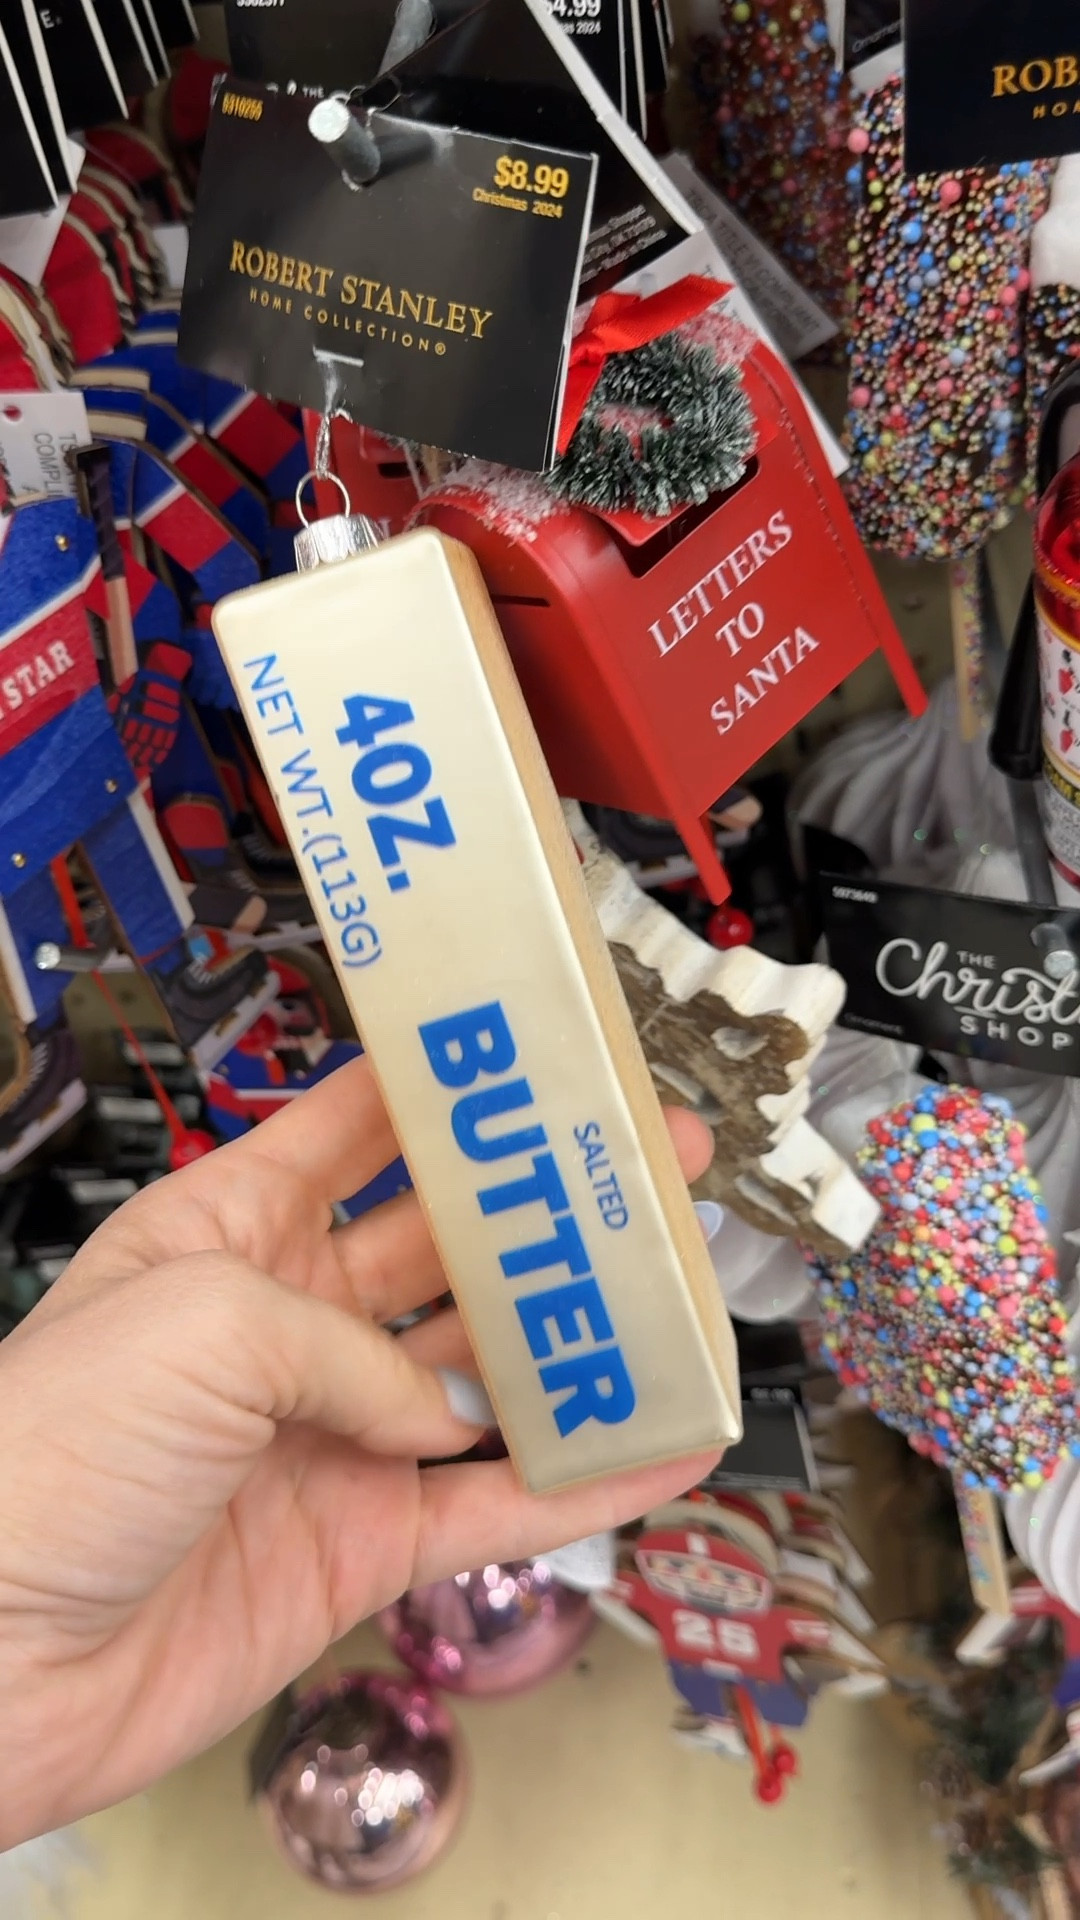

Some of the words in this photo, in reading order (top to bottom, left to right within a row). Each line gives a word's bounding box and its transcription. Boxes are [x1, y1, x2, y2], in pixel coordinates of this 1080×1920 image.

[302, 86, 325, 99] THE
[991, 55, 1080, 98] ROB
[472, 187, 528, 212] Christmas
[532, 200, 563, 218] 2024
[494, 155, 569, 198] $8.99
[229, 239, 334, 298] ROBERT
[341, 274, 493, 339] STANLEY
[250, 286, 292, 314] HOME
[647, 509, 793, 658] LETTERS
[715, 602, 765, 657] TO
[0, 640, 75, 719] STAR
[243, 653, 304, 736] NET
[710, 626, 820, 735] SANTA
[875, 937, 1080, 1025] Christ
[957, 950, 997, 970] THE
[960, 1015, 1074, 1051] SHOP
[573, 1121, 629, 1231] SALTED
[418, 1000, 636, 1439] BUTTER
